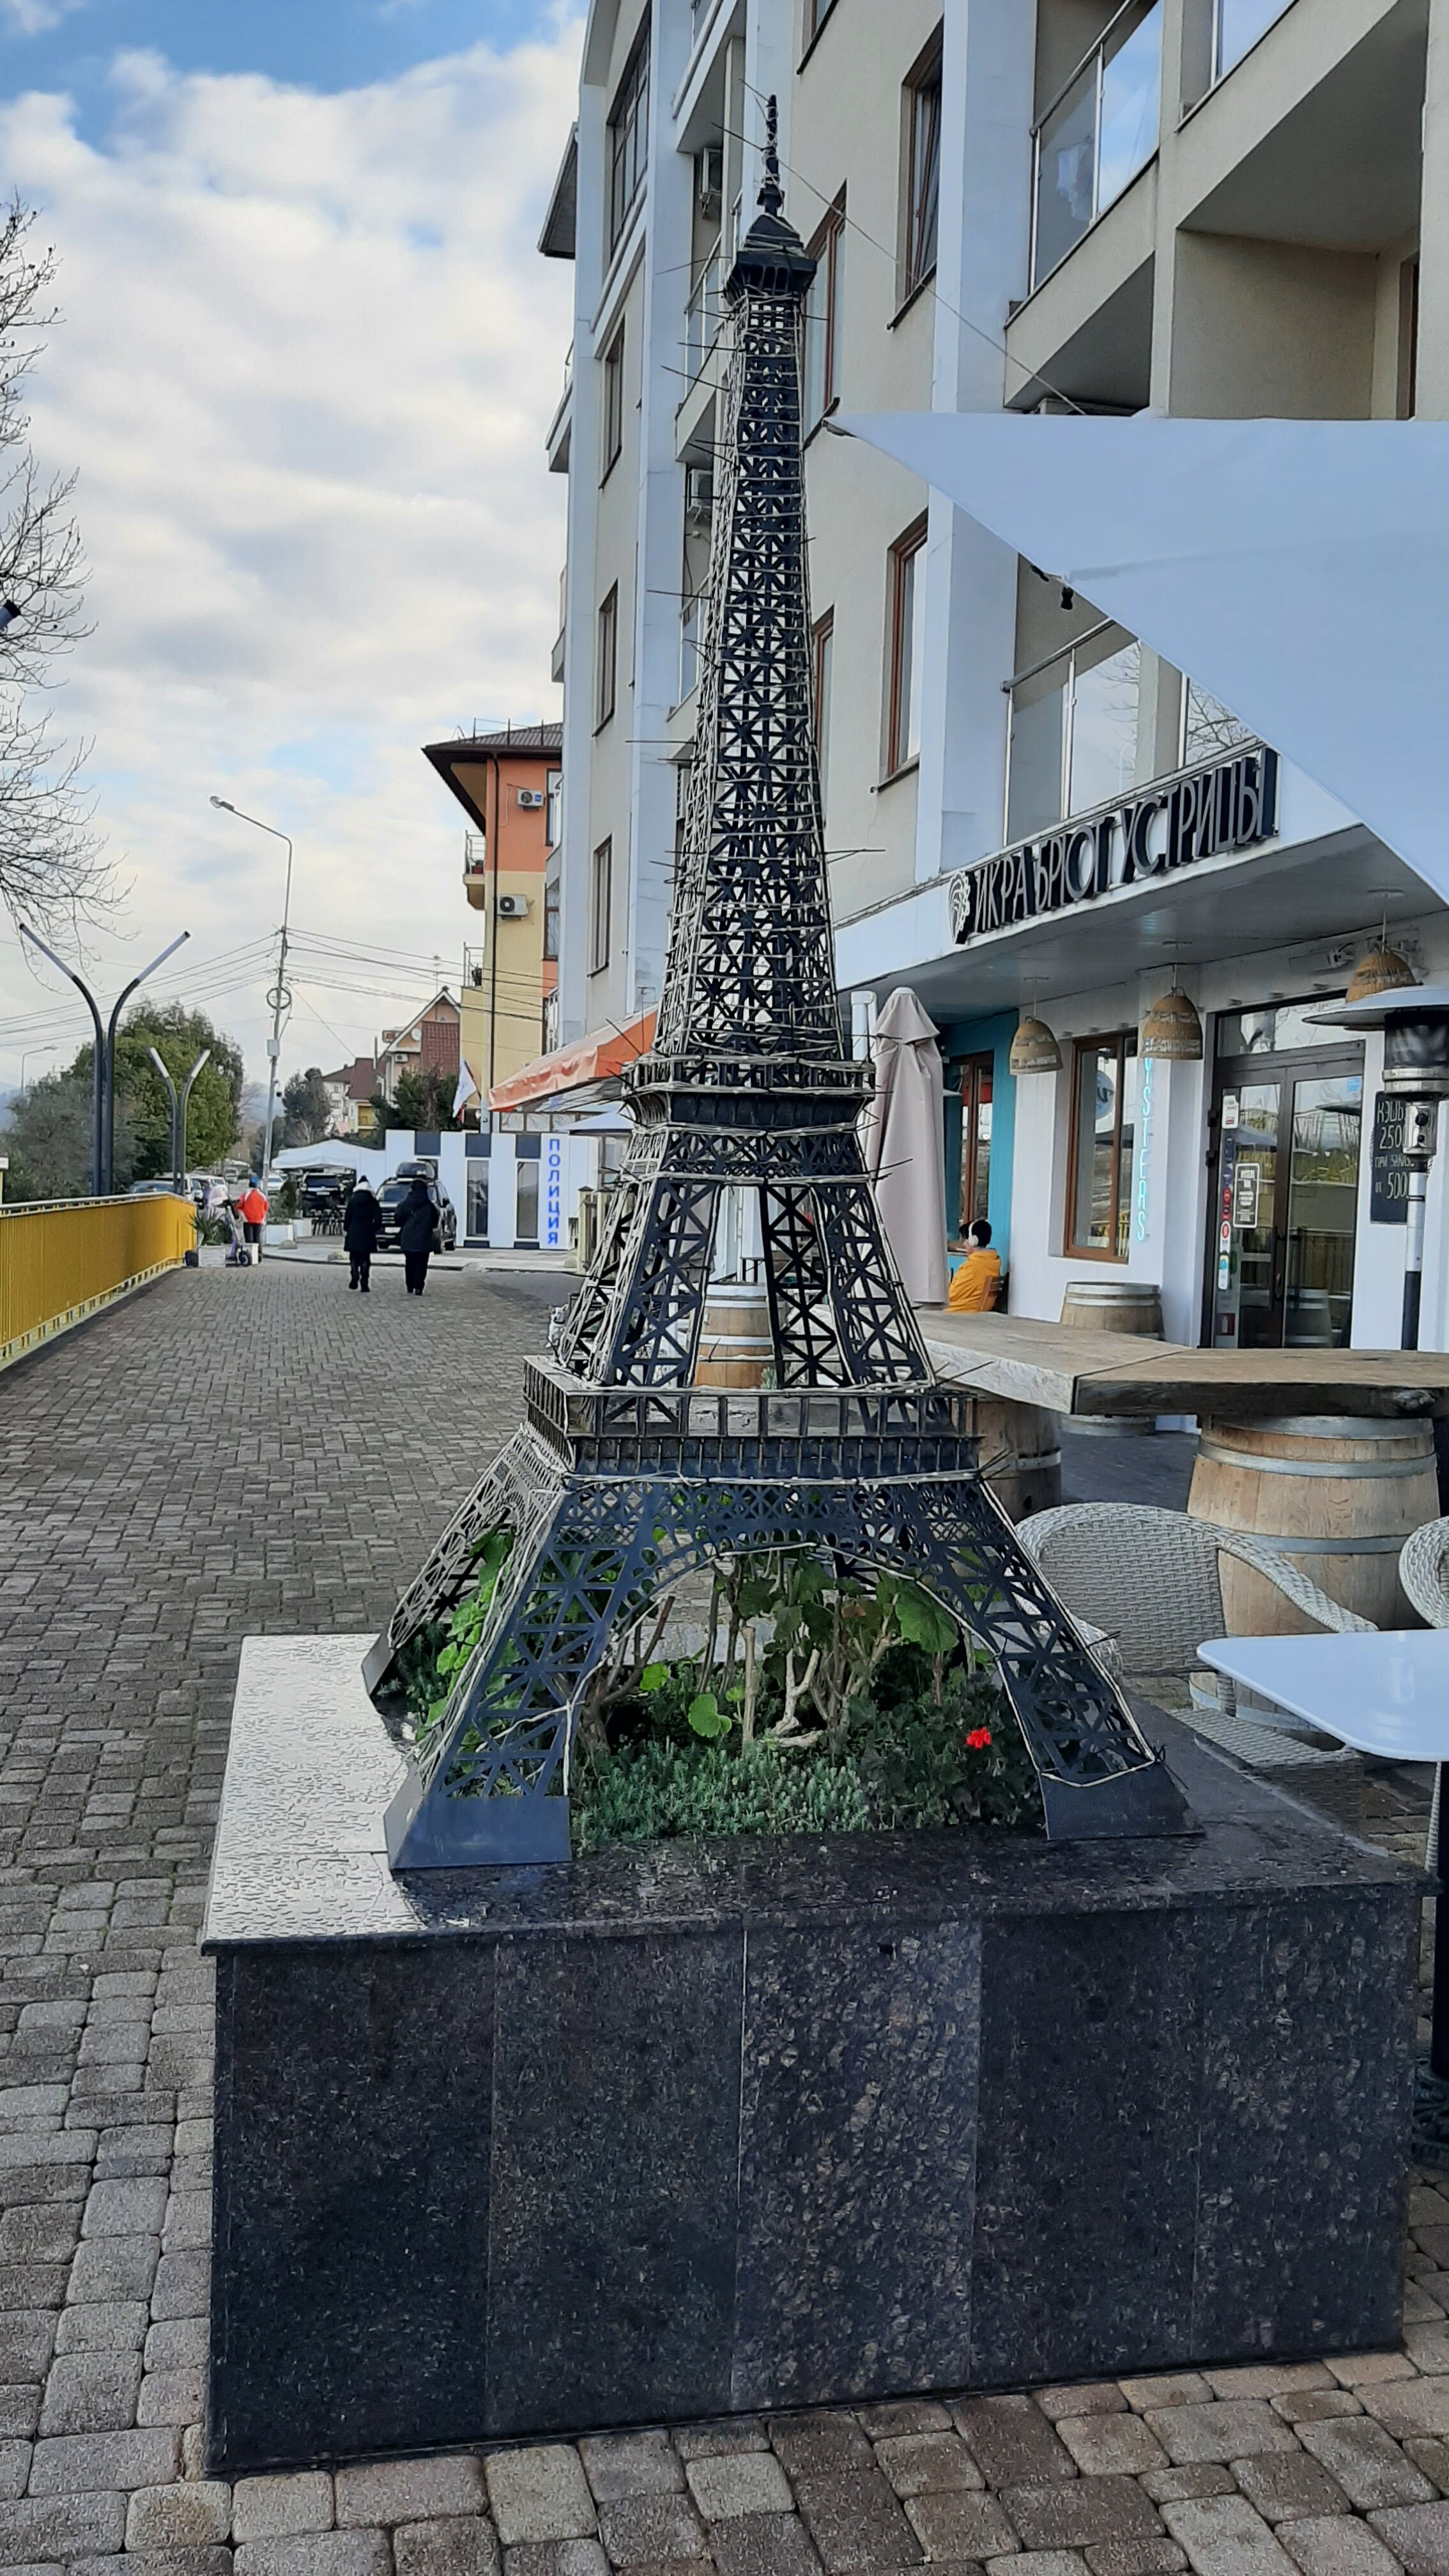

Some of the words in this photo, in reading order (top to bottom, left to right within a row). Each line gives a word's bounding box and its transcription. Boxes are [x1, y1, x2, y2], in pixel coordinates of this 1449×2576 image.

[974, 845, 1034, 933] ИКРА
[1034, 816, 1113, 912] БРЮТ
[1120, 747, 1276, 884] УСТРИЦЫ
[548, 1138, 561, 1245] ПОЛИЦИЯ
[1137, 1057, 1152, 1241] YSTERS
